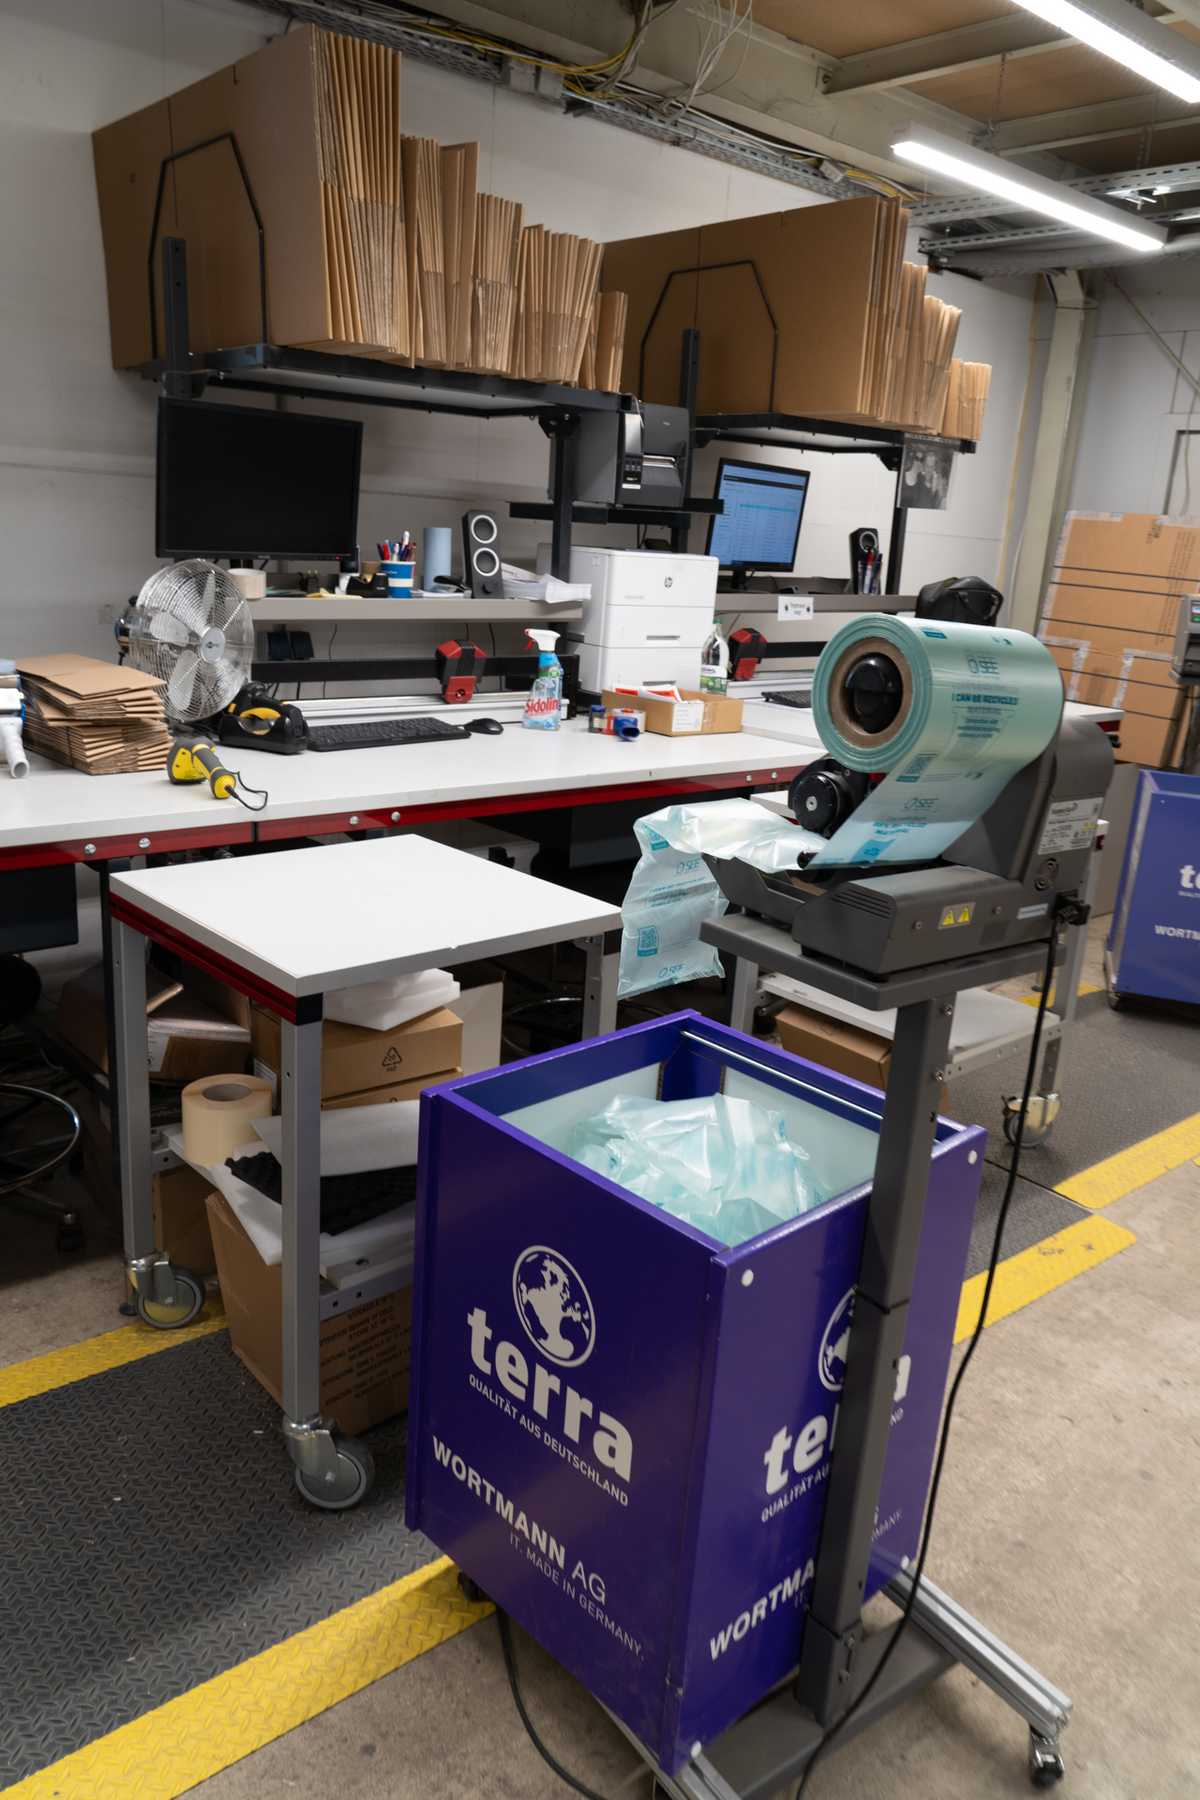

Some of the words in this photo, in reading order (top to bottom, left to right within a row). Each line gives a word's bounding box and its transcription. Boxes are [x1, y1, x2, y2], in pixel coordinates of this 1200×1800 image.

[467, 1305, 634, 1483] terra
[469, 1374, 519, 1420] QUALITÄT
[520, 1415, 541, 1439] AUS
[543, 1432, 629, 1507] DEUTSCHLAND
[432, 1435, 566, 1570] WORTMANN
[572, 1560, 606, 1606] AG
[814, 1463, 829, 1485] AU
[527, 1547, 560, 1586] MADE
[563, 1578, 576, 1600] IN
[709, 1556, 815, 1662] WORTMA
